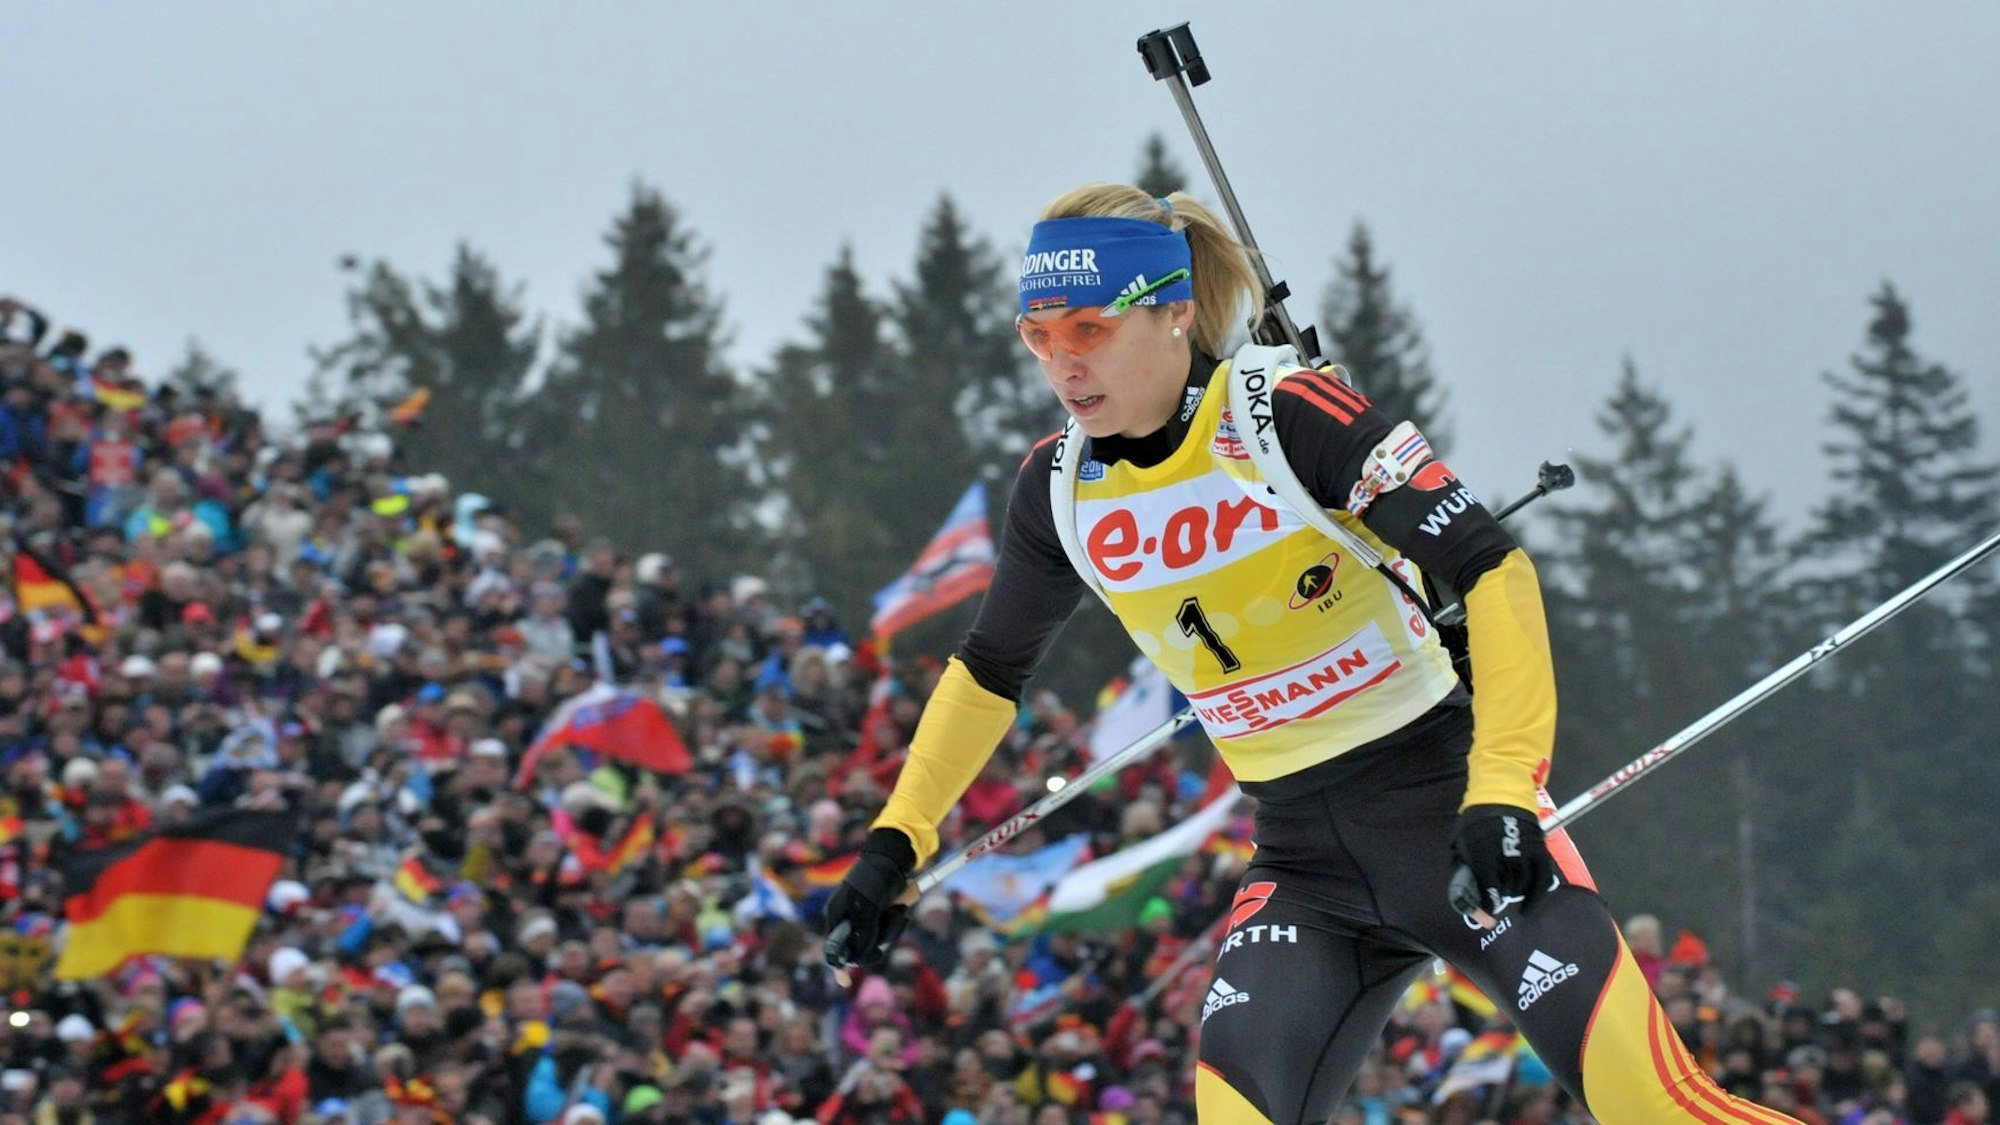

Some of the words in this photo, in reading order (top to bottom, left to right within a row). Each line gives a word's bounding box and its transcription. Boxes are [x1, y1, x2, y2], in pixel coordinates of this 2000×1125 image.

[1317, 590, 1343, 613] IBU
[1175, 596, 1241, 675] 1
[1199, 647, 1369, 729] VIESSMANN
[1216, 924, 1298, 964] RTH
[1480, 916, 1513, 951] Audi
[1518, 963, 1580, 1011] adidas
[1200, 991, 1251, 1028] didas
